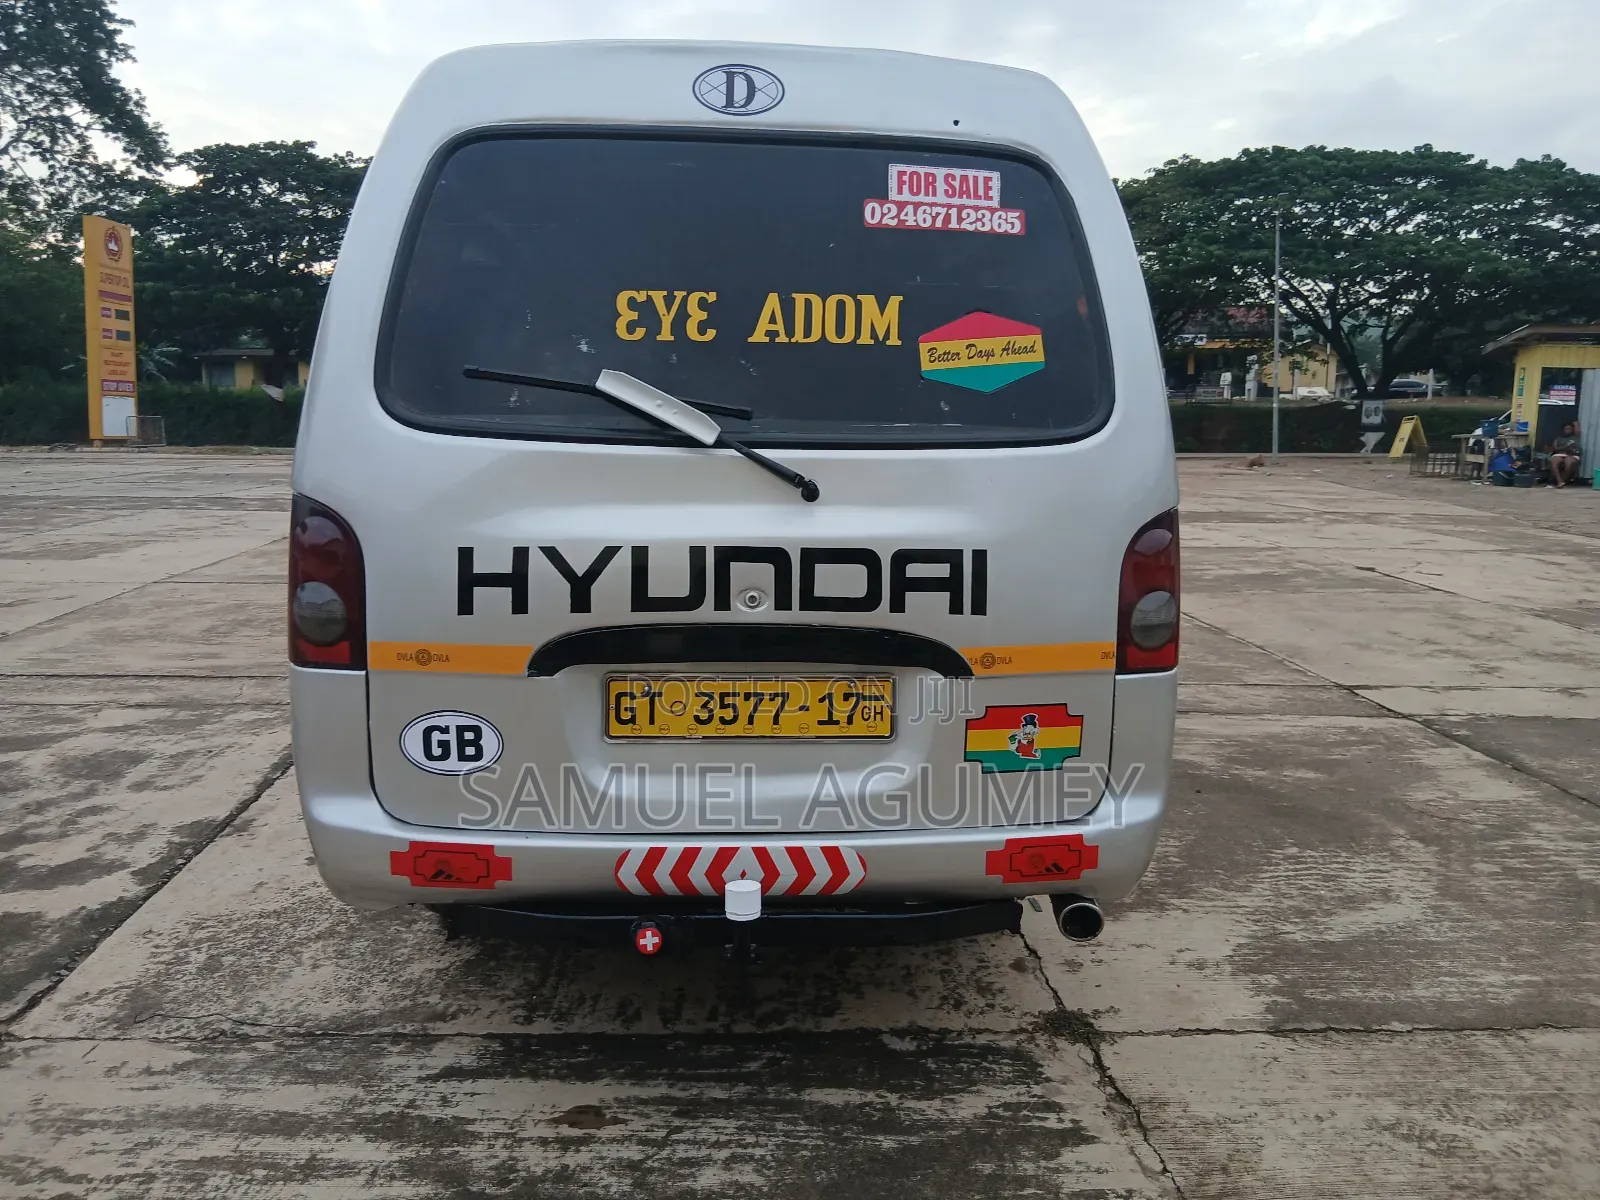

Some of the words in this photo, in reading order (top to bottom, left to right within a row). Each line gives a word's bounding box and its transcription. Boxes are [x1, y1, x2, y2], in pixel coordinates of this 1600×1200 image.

[721, 70, 756, 109] D
[896, 170, 938, 198] FOR
[943, 172, 994, 201] SALE
[864, 202, 1021, 233] 0246712365
[747, 292, 904, 346] ADOM
[926, 346, 962, 364] Better
[965, 343, 996, 362] Days
[1000, 340, 1037, 358] Ahead
[102, 381, 117, 391] STOP
[117, 382, 134, 392] OVER
[456, 545, 988, 616] HYUNDAI
[396, 652, 414, 662] DVLA
[432, 653, 450, 663] DVLA
[966, 657, 979, 666] VLA
[996, 656, 1013, 665] DVLA
[1101, 651, 1115, 660] DVLA
[614, 691, 663, 726] GT
[861, 704, 884, 722] GH
[422, 724, 484, 763] GB
